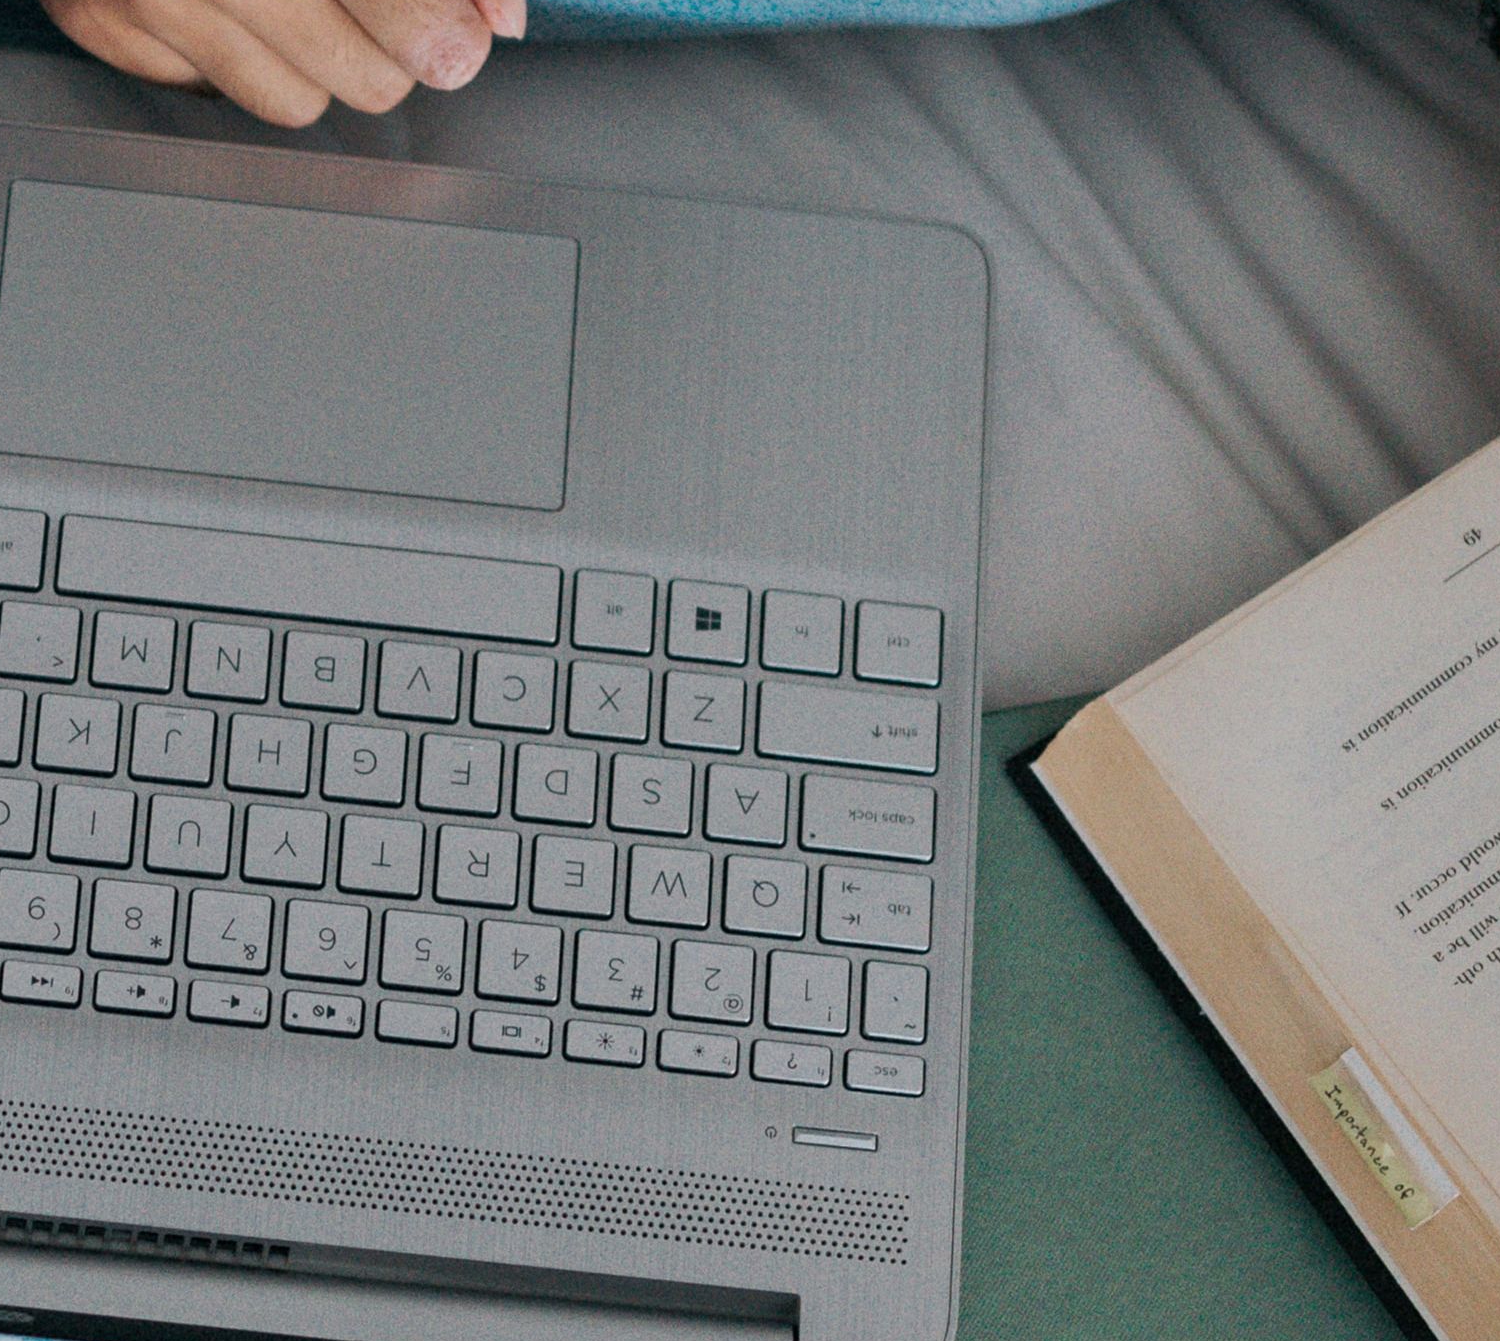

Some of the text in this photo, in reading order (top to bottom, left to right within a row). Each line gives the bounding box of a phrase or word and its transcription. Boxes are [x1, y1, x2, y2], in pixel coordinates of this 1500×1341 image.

[1460, 526, 1484, 548] 49
[119, 633, 150, 665] M
[215, 644, 243, 675] N
[312, 654, 338, 685] B
[405, 664, 433, 694] V
[501, 673, 529, 704] C
[597, 683, 623, 714] X
[691, 693, 717, 725] Z
[66, 716, 93, 747] K
[162, 726, 184, 756] J
[885, 723, 920, 742] shift
[256, 737, 284, 768] H
[351, 746, 380, 778] G
[448, 759, 473, 788] F
[542, 767, 571, 798] D
[640, 776, 664, 807] S
[732, 786, 761, 817] A
[846, 807, 917, 827] caps lock
[175, 818, 203, 849] U
[272, 829, 299, 859] Y
[369, 839, 394, 869] T
[465, 848, 492, 880] R
[562, 858, 587, 890] E
[649, 869, 689, 900] W
[750, 878, 782, 910] Q
[885, 901, 913, 918] tab
[873, 1064, 900, 1079] esc
[1322, 1087, 1414, 1202] Importance of
